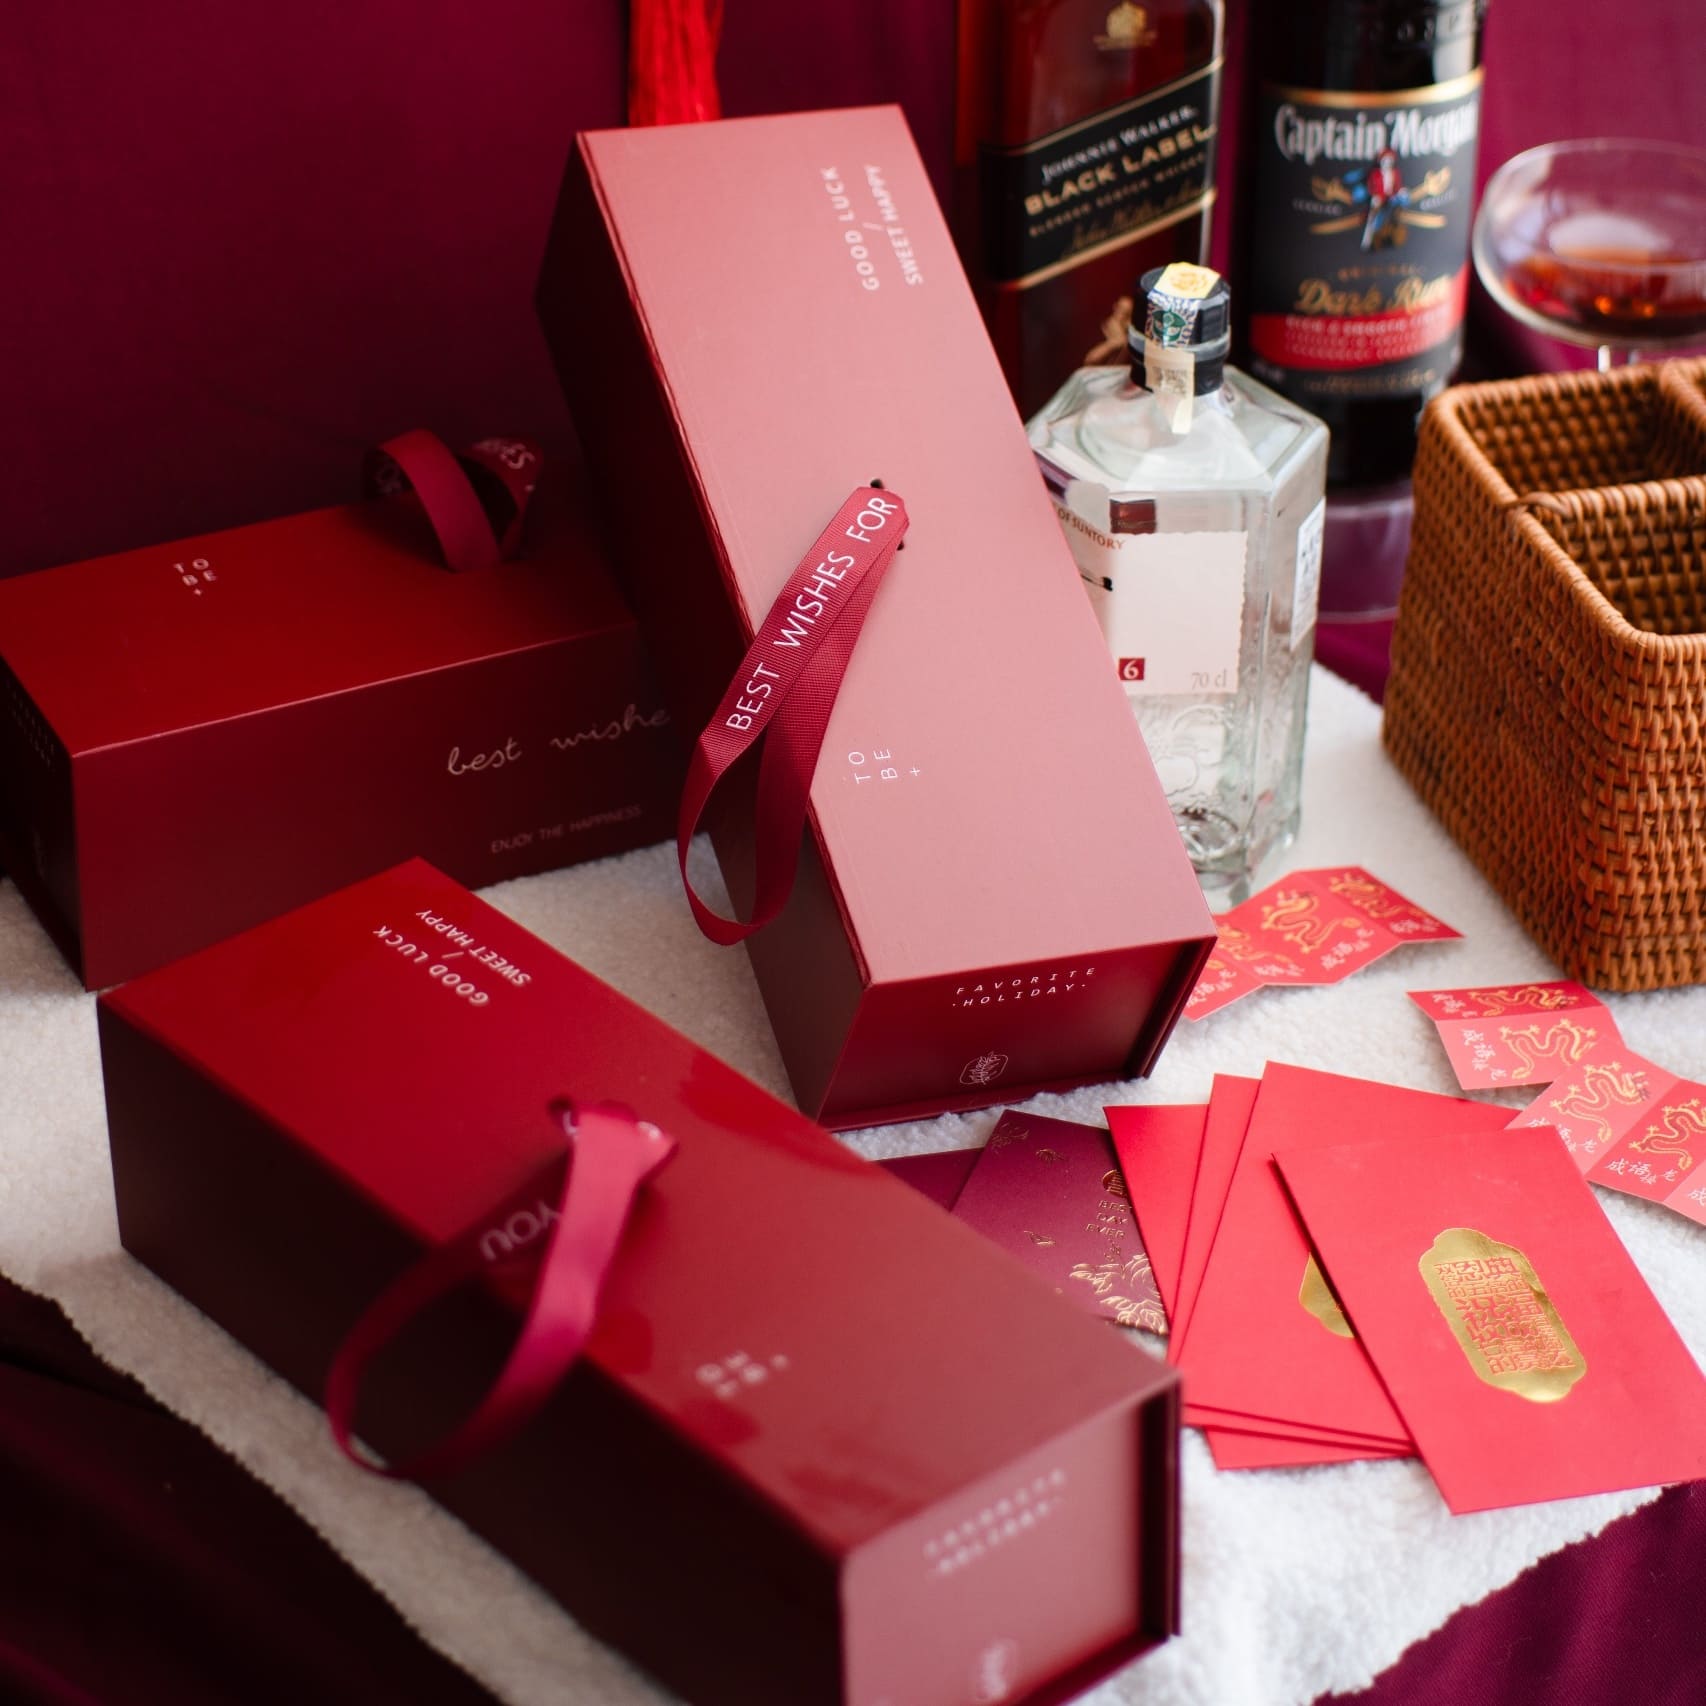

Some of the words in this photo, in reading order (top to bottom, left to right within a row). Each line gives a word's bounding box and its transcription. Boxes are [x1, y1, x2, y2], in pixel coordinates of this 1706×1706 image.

[1274, 104, 1388, 165] Captain
[1024, 162, 1117, 215] BLACK
[1121, 123, 1217, 173] LABEL
[820, 166, 855, 222] LUCK
[864, 164, 899, 222] HAPPY
[844, 229, 881, 291] GOOD
[886, 226, 924, 286] SWEET
[1071, 516, 1126, 551] SUNTORY
[725, 661, 780, 732] BEST
[773, 549, 855, 648] WISHES
[846, 496, 899, 543] FOR
[1122, 659, 1139, 680] 6
[1190, 671, 1211, 690] 70
[447, 737, 522, 776] best
[848, 751, 872, 785] TO
[873, 749, 899, 780] BE
[490, 833, 534, 854] ENJOY
[539, 823, 564, 841] THE
[569, 804, 642, 832] HAPPINESS
[372, 925, 429, 964] LUCK
[415, 909, 475, 947] HAPPY
[428, 963, 490, 1006] GOOD
[469, 945, 532, 987] SWEET
[956, 967, 1095, 995] FAVORITE
